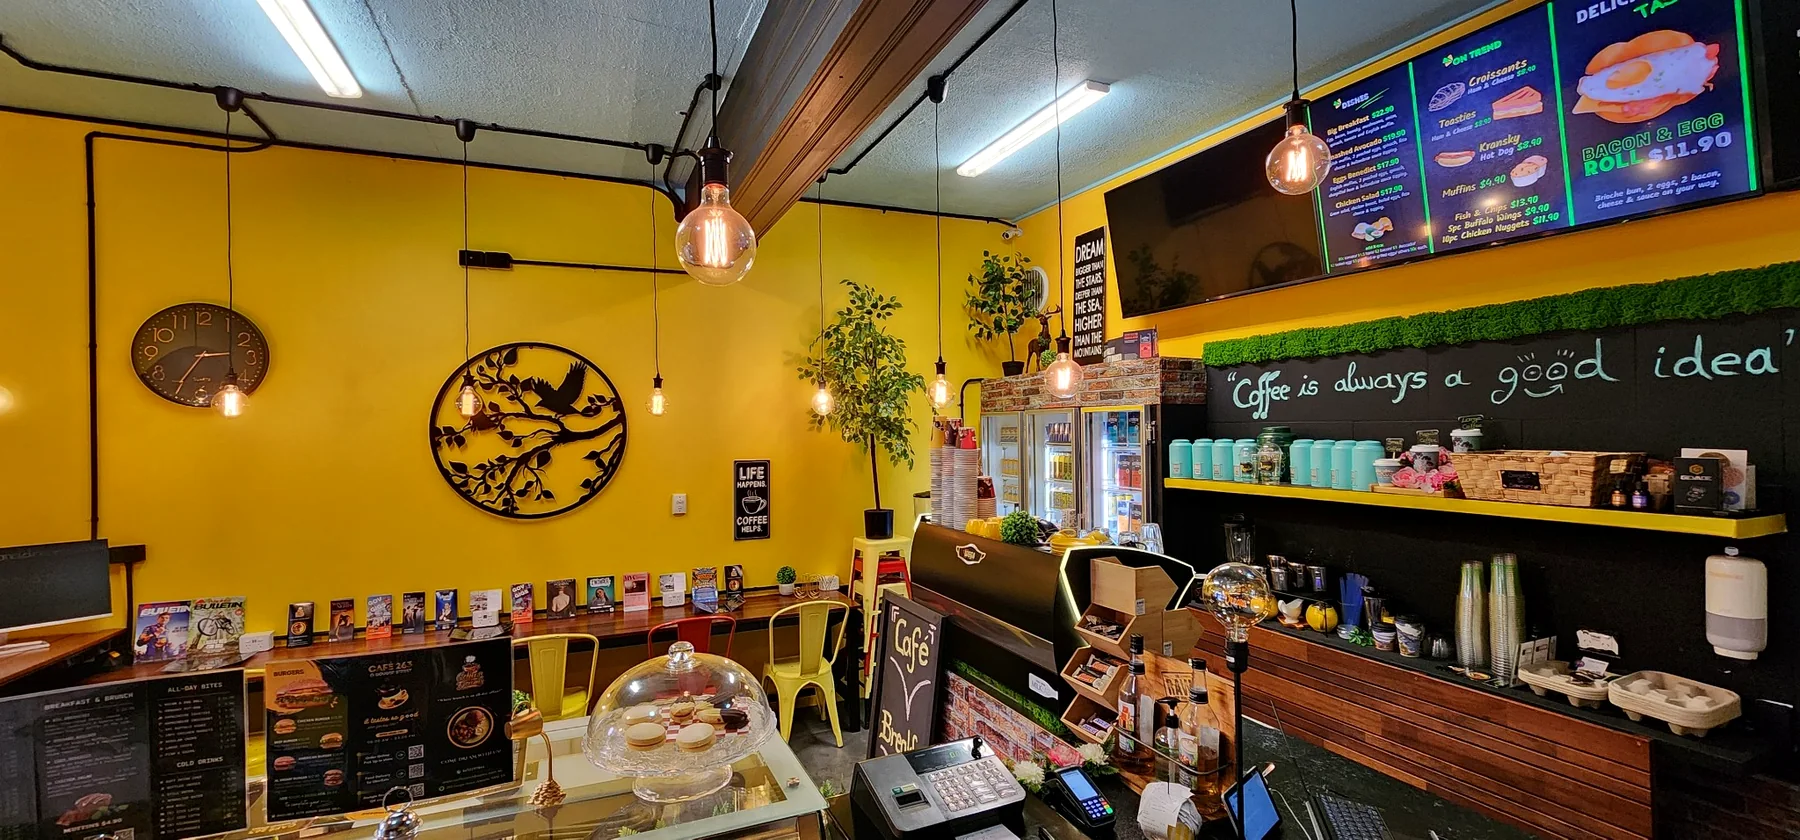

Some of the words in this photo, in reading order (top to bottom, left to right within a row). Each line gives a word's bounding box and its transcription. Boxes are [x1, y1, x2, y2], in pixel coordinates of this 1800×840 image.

[1452, 54, 1468, 66] ON
[1469, 40, 1502, 59] TREND
[1468, 59, 1528, 87] Croissants
[1483, 81, 1490, 89] &
[1491, 73, 1515, 86] Cheese
[1341, 93, 1369, 110] DISHES
[1327, 127, 1338, 136] Big
[1338, 115, 1370, 131] Breakfast
[1371, 105, 1395, 119] $22.90
[1438, 110, 1477, 129] Toasties
[1452, 125, 1473, 135] Cheese
[1582, 132, 1651, 162] BACON
[1656, 127, 1673, 143] &
[1677, 112, 1724, 138] EGG
[1353, 138, 1383, 153] Avocado
[1382, 129, 1406, 142] $19.90
[1479, 134, 1521, 153] Kransky
[1480, 150, 1495, 162] Hot
[1497, 147, 1515, 157] Dog
[1516, 137, 1543, 152] $8.90
[1584, 149, 1644, 177] ROLL
[1648, 131, 1732, 163] $11.90
[1332, 174, 1347, 185] Eggs
[1347, 165, 1377, 179] Benedict
[1376, 157, 1400, 170] $17.90
[1442, 183, 1477, 198] Muffins
[1479, 174, 1507, 189] $4.90
[1594, 190, 1624, 203] Brioche
[1626, 186, 1644, 196] bun,
[1647, 183, 1654, 191] 2
[1656, 180, 1679, 190] eggs,
[1680, 175, 1688, 184] 2
[1690, 170, 1721, 182] bacon,
[1597, 199, 1624, 210] cheese
[1625, 196, 1634, 204] &
[1636, 191, 1660, 201] sauce
[1662, 188, 1674, 196] on
[1675, 183, 1697, 195] your
[1697, 179, 1720, 189] way.
[1335, 198, 1361, 209] Chicken
[1361, 190, 1380, 201] Salad
[1380, 184, 1403, 196] $17.90
[1454, 212, 1472, 221] Fish
[1473, 209, 1482, 217] &
[1484, 204, 1508, 215] Chips
[1510, 195, 1539, 209] $13.90
[1464, 217, 1494, 229] Buffalo
[1496, 210, 1522, 222] Wings
[1524, 203, 1550, 216] $9.90
[1442, 234, 1458, 244] 10pc
[1460, 227, 1493, 239] Chicken
[1495, 219, 1530, 233] Nuggets
[1532, 212, 1560, 225] $11.90
[1075, 237, 1104, 264] DREAM
[1075, 263, 1092, 277] BIGGER
[1091, 259, 1104, 271] THAN
[1075, 277, 1086, 290] THE
[1075, 287, 1091, 301] DEEPER
[1091, 285, 1103, 297] THAN
[1075, 300, 1087, 316] THE
[172, 313, 187, 330] 11
[195, 311, 213, 326] 12
[1075, 313, 1103, 333] HIGHER
[153, 327, 175, 343] 10
[237, 332, 251, 347] 2
[1074, 333, 1091, 347] THAN
[1090, 331, 1103, 344] THE
[144, 345, 159, 361] 9
[245, 350, 257, 366] 3
[1073, 344, 1103, 358] MOUNTAINS
[151, 364, 166, 381] 8
[1297, 374, 1319, 397] is
[1334, 361, 1429, 404] always
[1444, 369, 1473, 389] a
[1490, 336, 1621, 405] good
[739, 466, 765, 481] LIFE
[736, 481, 767, 489] HAPPENS.
[736, 515, 768, 526] COFFEE
[140, 604, 190, 617] BULLETIN
[194, 601, 243, 610] BULLETIN
[894, 618, 930, 674] Café
[273, 669, 305, 677] BURGERS
[395, 660, 413, 670] 263
[167, 684, 198, 693] ALL-DAY
[201, 682, 223, 690] BITES
[44, 698, 91, 711] BREAKFAST
[104, 692, 134, 702] BRUNCH
[176, 760, 195, 768] COLD
[197, 756, 224, 765] DRINKS
